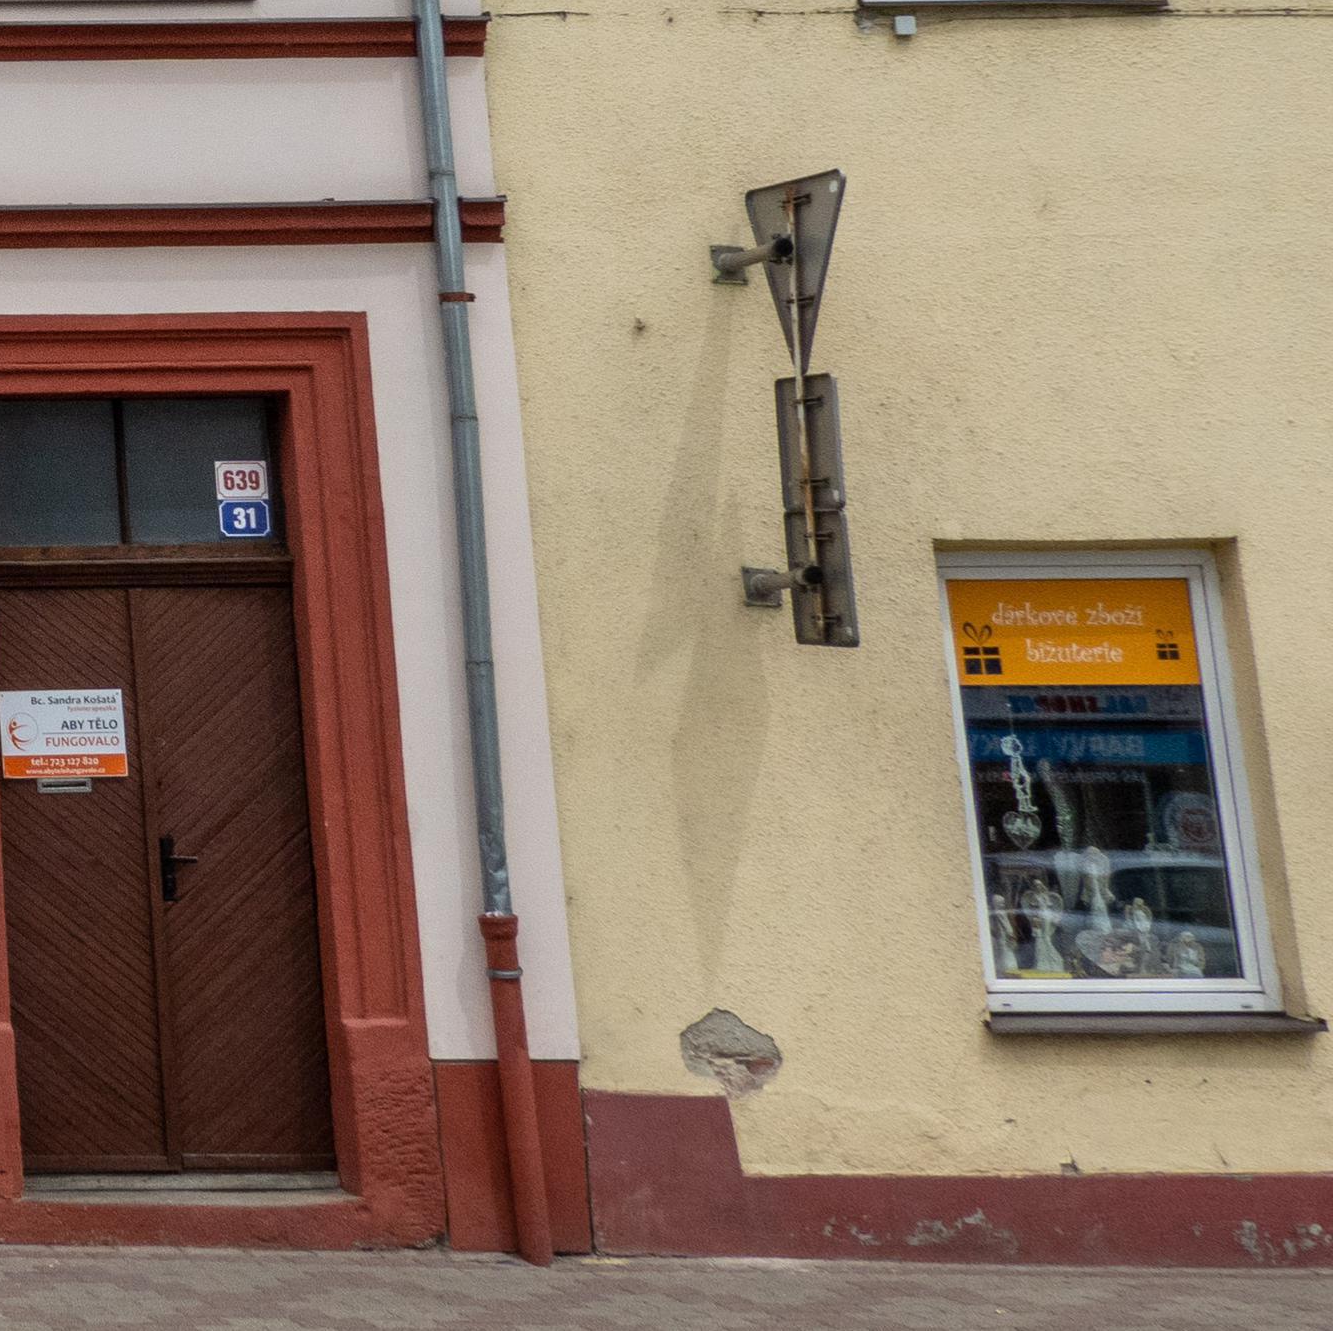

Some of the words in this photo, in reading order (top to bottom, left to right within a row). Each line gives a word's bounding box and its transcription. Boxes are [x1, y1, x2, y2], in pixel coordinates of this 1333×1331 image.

[222, 470, 260, 490] 639
[233, 507, 256, 529] 31
[991, 602, 1078, 626] dárkové
[1085, 602, 1144, 626] zboží
[1025, 638, 1124, 663] bižuterie
[31, 696, 46, 705] Bc.
[48, 695, 81, 705] Sandra
[84, 694, 117, 704] Košatá
[61, 720, 85, 730] ABY
[86, 718, 118, 730] TĚLO
[45, 735, 120, 747] FUNGOVALO
[82, 756, 99, 765] 820
